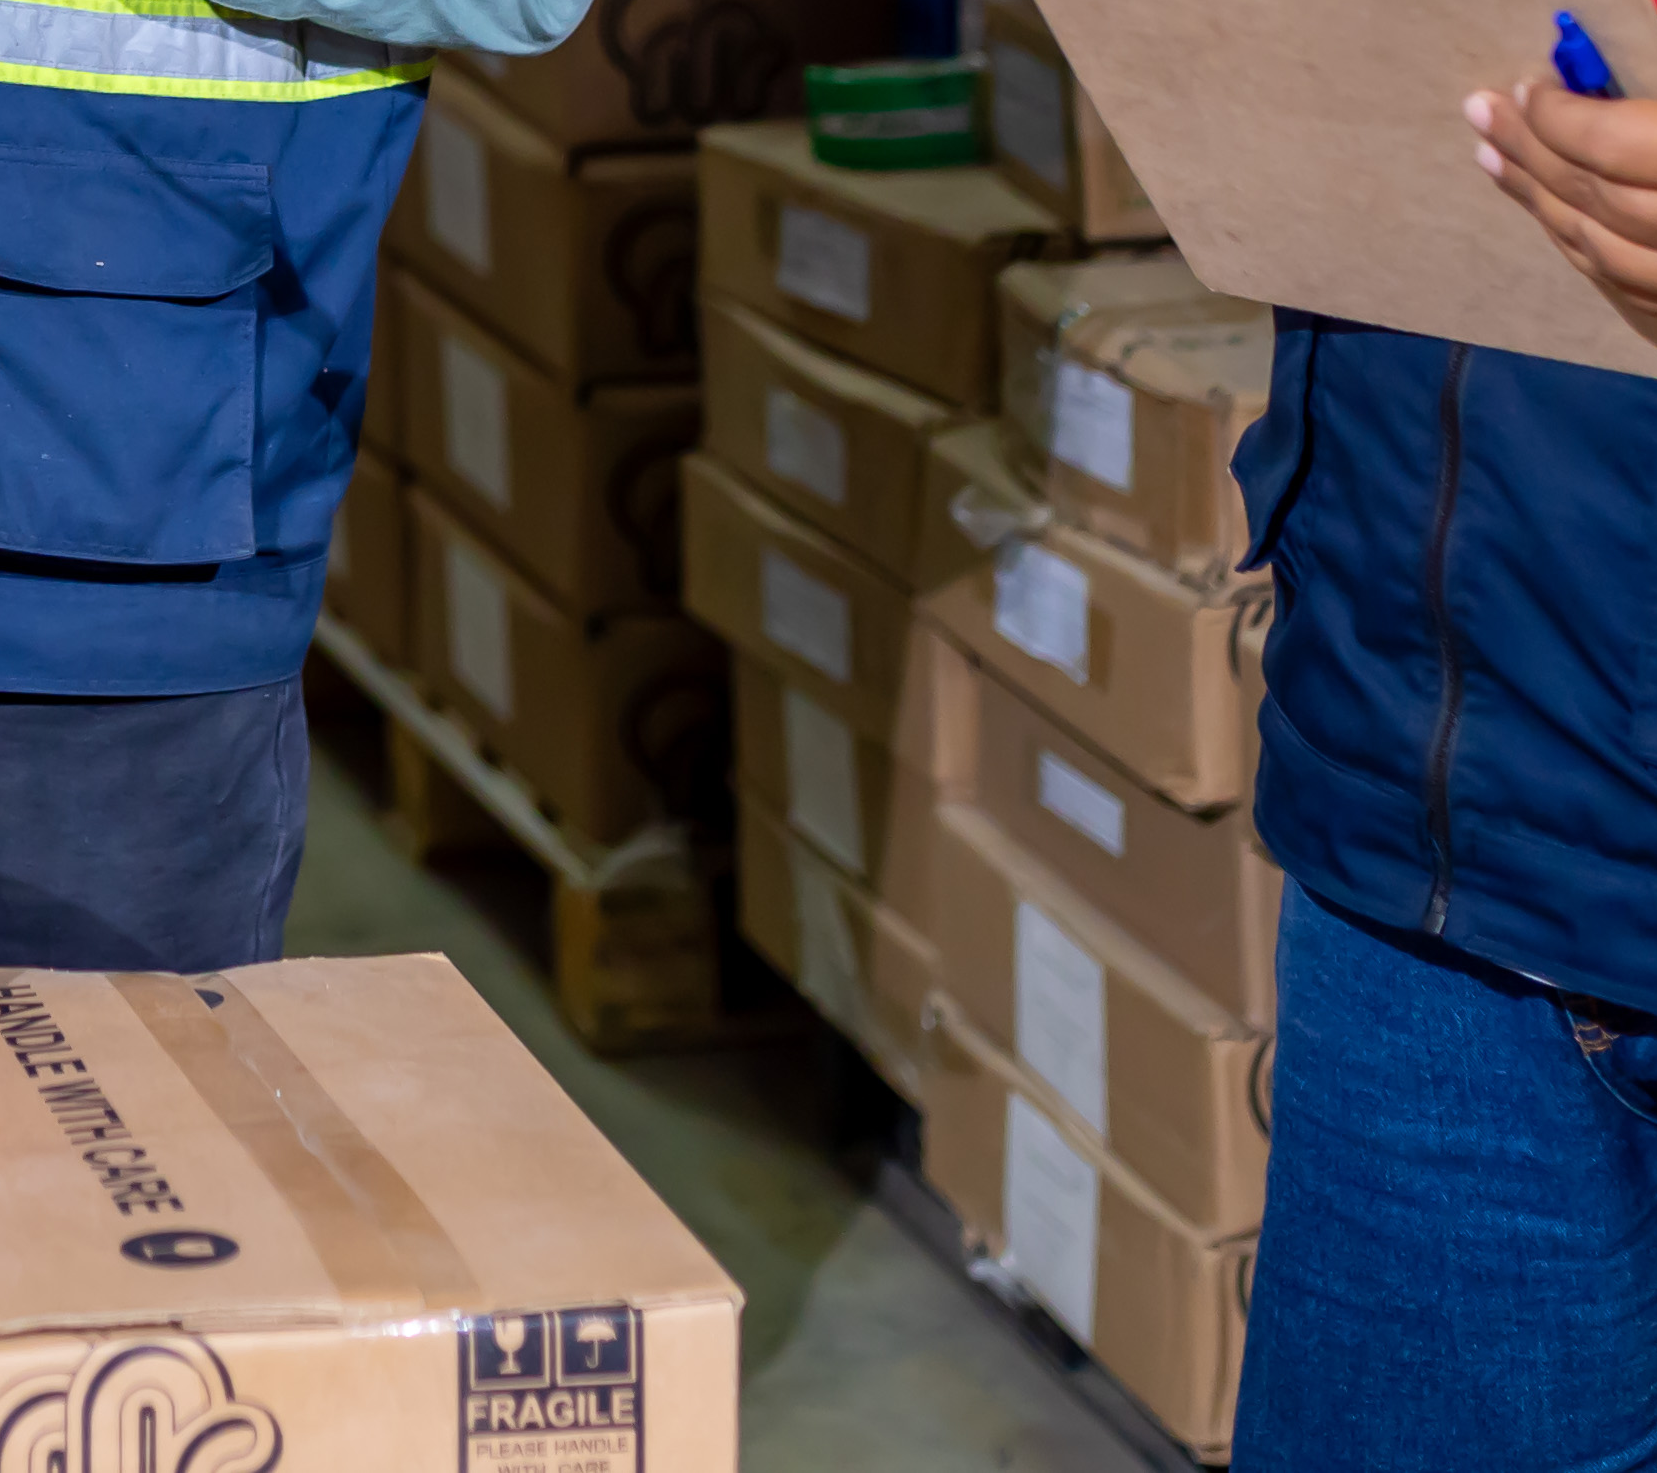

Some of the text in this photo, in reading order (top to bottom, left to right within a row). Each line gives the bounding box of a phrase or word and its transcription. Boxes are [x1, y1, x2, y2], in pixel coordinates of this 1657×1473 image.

[37, 1078, 133, 1146] WITH
[82, 1147, 185, 1217] CARE
[467, 1388, 636, 1434] FRAGILE
[476, 1436, 629, 1460] PLEASE HANDLE
